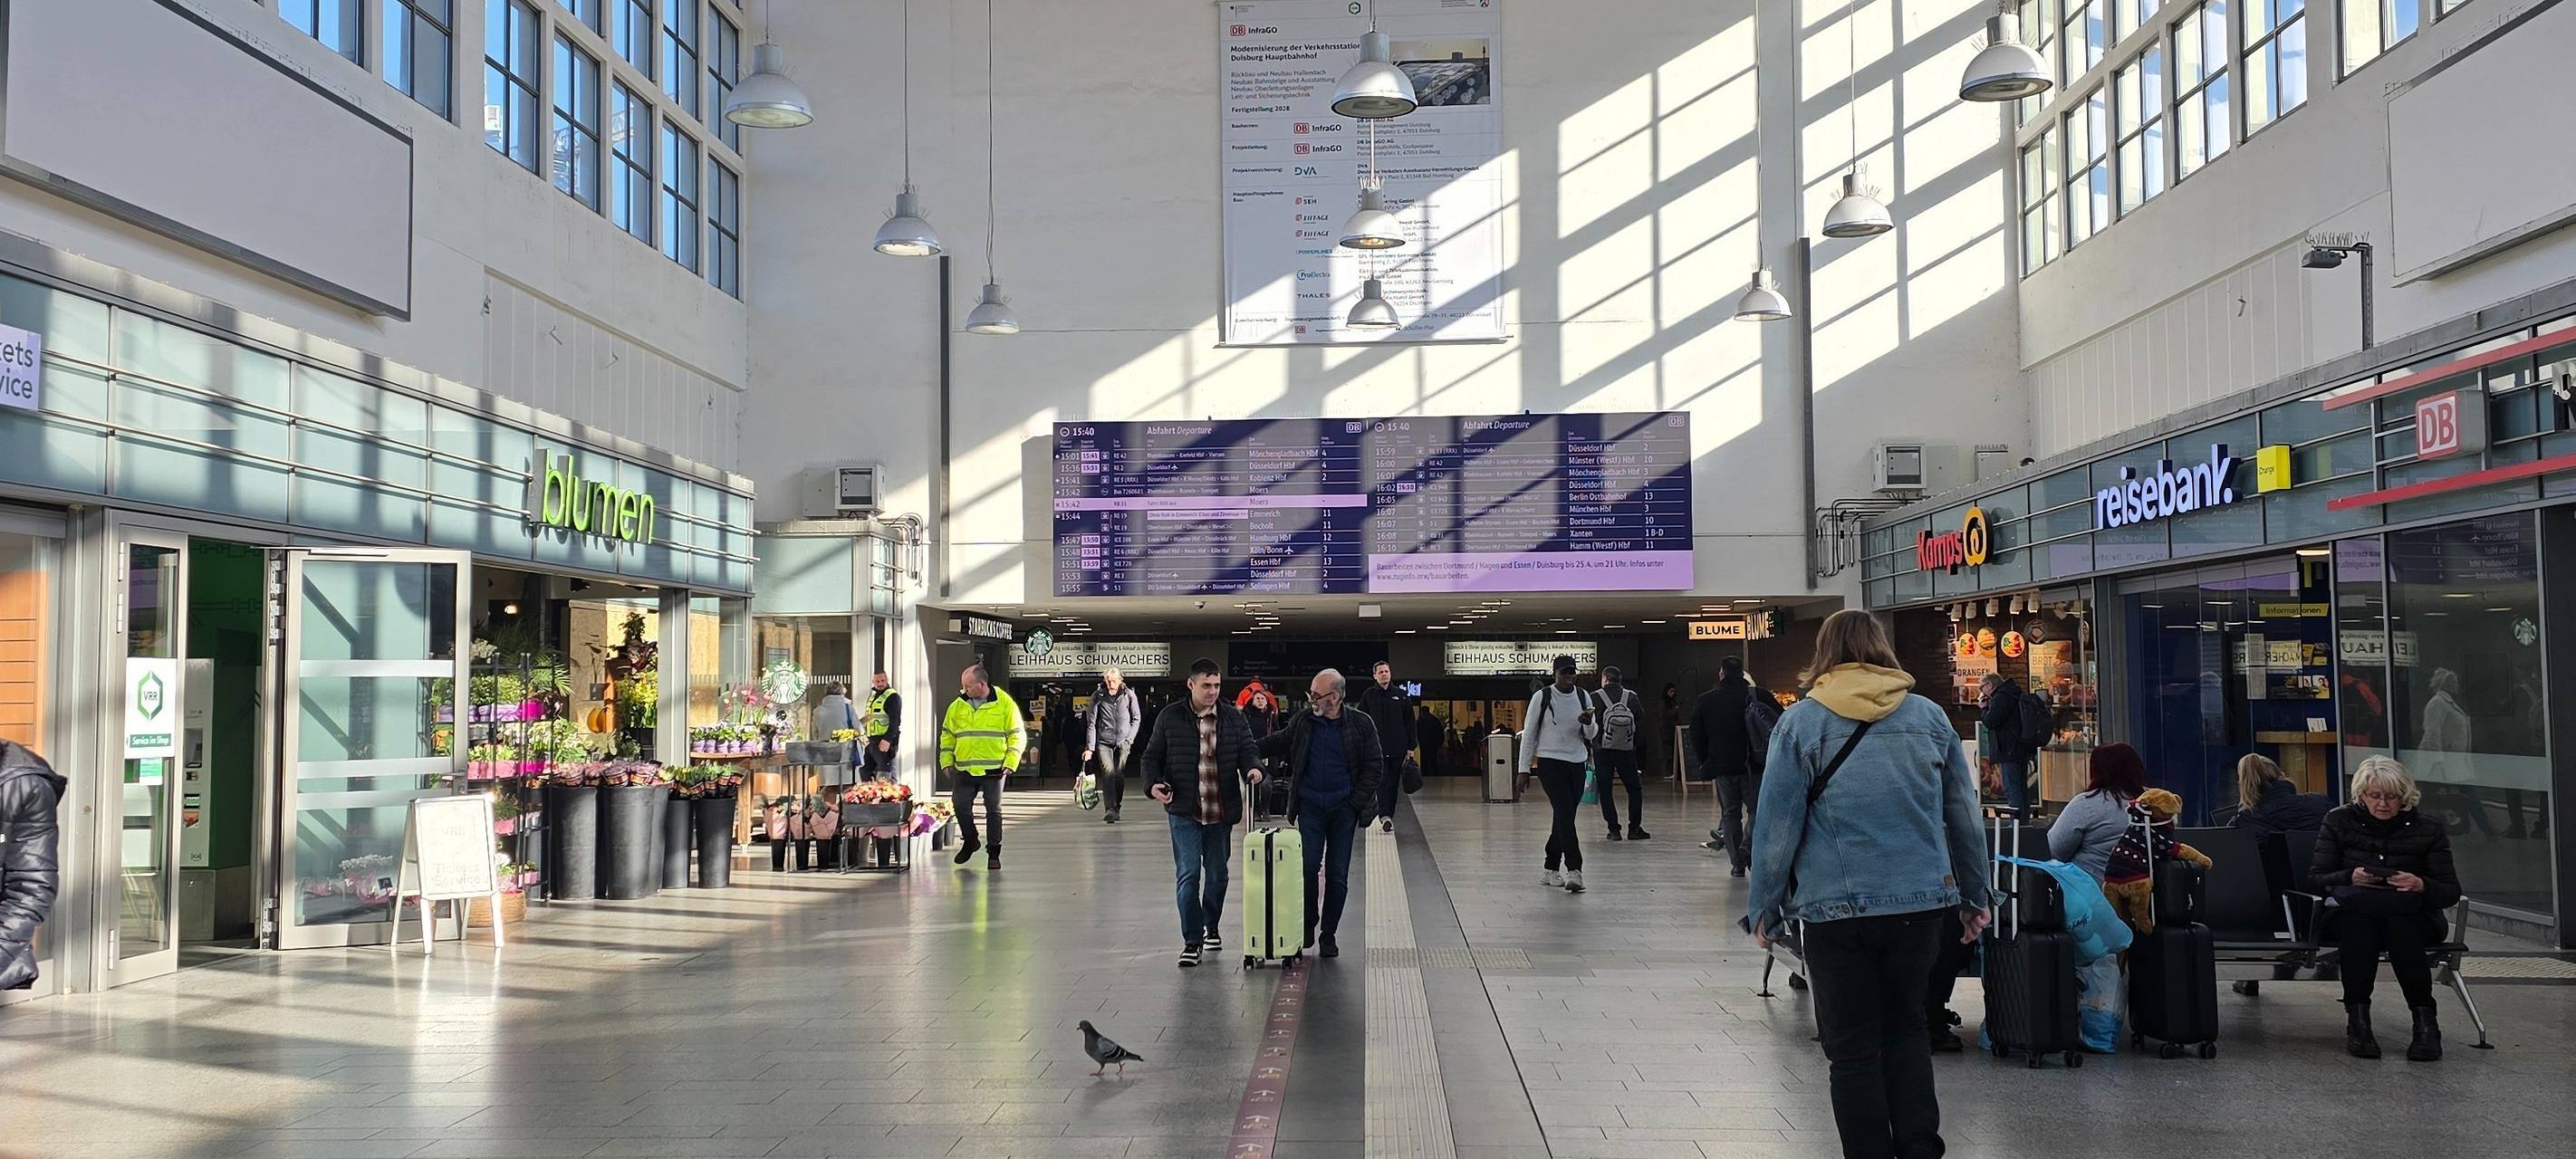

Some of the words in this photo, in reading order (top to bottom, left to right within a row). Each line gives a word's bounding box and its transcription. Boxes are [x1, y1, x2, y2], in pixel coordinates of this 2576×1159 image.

[1231, 25, 1245, 35] DB
[1265, 53, 1317, 62] Hauptbahnhof
[1295, 124, 1309, 133] DB
[1312, 124, 1341, 132] InfraGO
[1295, 144, 1309, 154] DB
[1294, 167, 1317, 176] DVA
[0, 340, 34, 369] ets
[1072, 426, 1095, 436] 15:40
[1147, 426, 1176, 435] Abfahrt
[1177, 426, 1213, 436] Departure
[1347, 423, 1360, 432] DB
[1464, 420, 1493, 429] Abfahrt
[1494, 419, 1530, 430] Departure
[1669, 417, 1683, 426] DB
[2419, 398, 2456, 454] DB
[1061, 452, 1080, 461] 15:01
[1249, 448, 1305, 458] Mönchengladbach
[1306, 448, 1319, 457] Hbf
[1322, 449, 1327, 457] 4
[1377, 447, 1396, 456] 15:59
[1568, 444, 1602, 453] Düsseldorf
[1603, 444, 1616, 452] Hbf
[1643, 443, 1648, 451] 2
[1061, 464, 1080, 473] 15:36
[1249, 461, 1283, 470] Düsseldorf
[1283, 461, 1295, 470] Hbf
[1322, 460, 1327, 469] 4
[1377, 459, 1396, 468] 16:00
[1568, 456, 1595, 465] Münster
[1596, 456, 1621, 465] (Westf)
[1622, 455, 1635, 465] Hbf
[1644, 455, 1653, 464] 10
[1061, 476, 1080, 484] 15:41
[1249, 474, 1274, 482] Koblenz
[1274, 474, 1287, 482] Hbf
[1322, 473, 1327, 482] 2
[1377, 471, 1396, 480] 16:01
[1569, 468, 1627, 478] Mönchengladbach
[1628, 468, 1639, 476] Hbf
[1644, 467, 1648, 475] 3
[1377, 484, 1396, 493] 16:02
[1569, 480, 1603, 489] Düsseldorf
[1604, 480, 1616, 488] Hbf
[1643, 479, 1648, 487] 4
[543, 447, 653, 544] blumen
[1061, 488, 1080, 497] 15:42
[1377, 495, 1396, 504] 16:05
[1569, 493, 1589, 501] Berlin
[1589, 492, 1627, 501] Ostbahnhof
[1644, 492, 1654, 501] 13
[1061, 500, 1081, 508] 15:42
[1249, 498, 1269, 506] Moers
[1061, 512, 1081, 521] 15:44
[1322, 509, 1331, 517] 11
[1377, 508, 1396, 516] 16:07
[1569, 504, 1599, 513] München
[1600, 504, 1611, 513] Hbf
[1644, 504, 1649, 512] 3
[1250, 522, 1274, 530] Bocholt
[1322, 521, 1331, 530] 11
[1377, 520, 1396, 528] 16:07
[1570, 517, 1602, 525] Dortmund
[1602, 516, 1616, 525] Hbf
[1645, 516, 1654, 524] 10
[1062, 536, 1081, 545] 15:47
[1250, 534, 1278, 543] Hamburg
[1279, 533, 1292, 542] Hbf
[1323, 532, 1332, 541] 12
[1570, 530, 1593, 538] Xanten
[1250, 545, 1283, 554] Köln/Bonn
[1323, 545, 1328, 553] 3
[1377, 544, 1397, 552] 16:10
[1570, 541, 1591, 550] Hamm
[1591, 541, 1617, 551] (Westf)
[1618, 541, 1630, 549] Hbf
[1645, 541, 1654, 549] 11
[1917, 530, 1963, 576] Kamps
[1062, 560, 1081, 569] 15:51
[1250, 558, 1269, 566] Essen
[1269, 558, 1282, 566] Hbf
[1323, 557, 1332, 565] 13
[1443, 562, 1474, 570] Dortmund
[1479, 562, 1500, 571] Hagen
[1514, 561, 1532, 570] Essen
[1537, 561, 1564, 570] Duisburg
[1062, 571, 1081, 580] 15:53
[1250, 570, 1283, 579] Düsseldorf
[1284, 570, 1296, 579] Hbf
[1323, 570, 1328, 578] 2
[1062, 584, 1081, 593] 15:55
[1250, 580, 1278, 591] Solingen
[1278, 580, 1290, 589] Hbf
[1323, 580, 1328, 589] 4
[2265, 605, 2321, 615] Informatonen
[968, 616, 995, 637] STARBUCKS
[996, 621, 1012, 640] COFFEE
[1697, 626, 1740, 635] BLUME
[1009, 655, 1072, 666] LEIHHAUS
[1076, 654, 1169, 666] SCHUMACHERS
[1447, 653, 1504, 664] LEIHHAUS
[1508, 653, 1596, 664] SCHUMAERS
[2032, 656, 2052, 666] BROT
[143, 691, 158, 701] VRR
